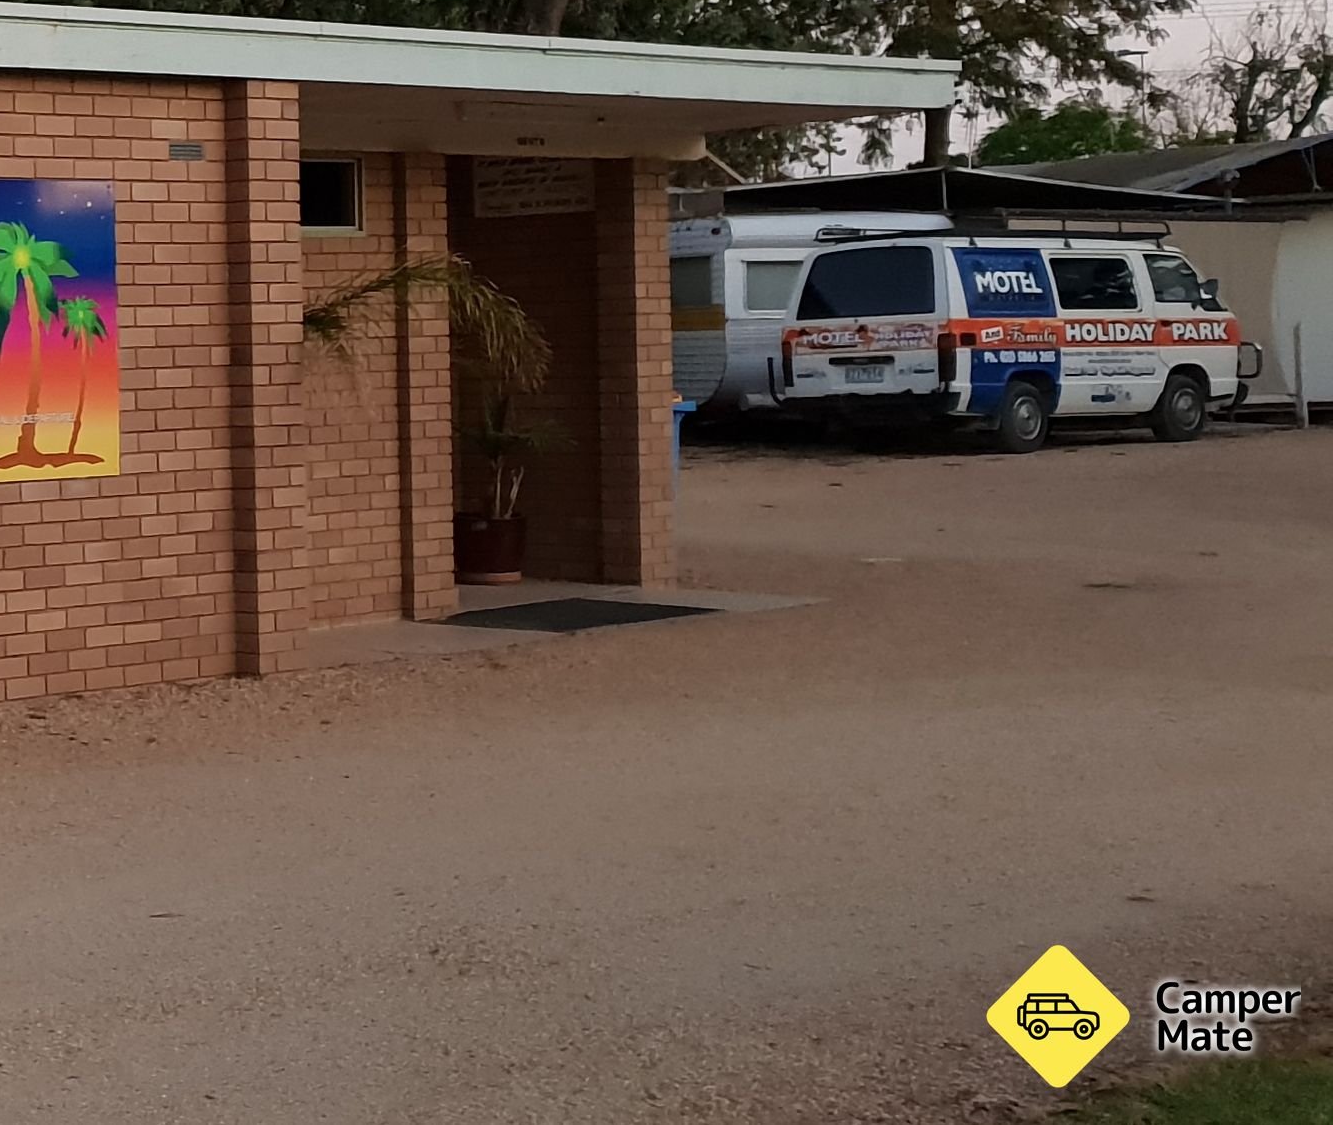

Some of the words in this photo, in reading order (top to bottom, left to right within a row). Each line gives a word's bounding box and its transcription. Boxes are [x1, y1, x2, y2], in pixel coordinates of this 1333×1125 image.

[974, 271, 1043, 294] MOTEL
[803, 332, 865, 345] MOTEL
[1065, 323, 1156, 342] HOLIDAY
[1171, 322, 1228, 341] PARK
